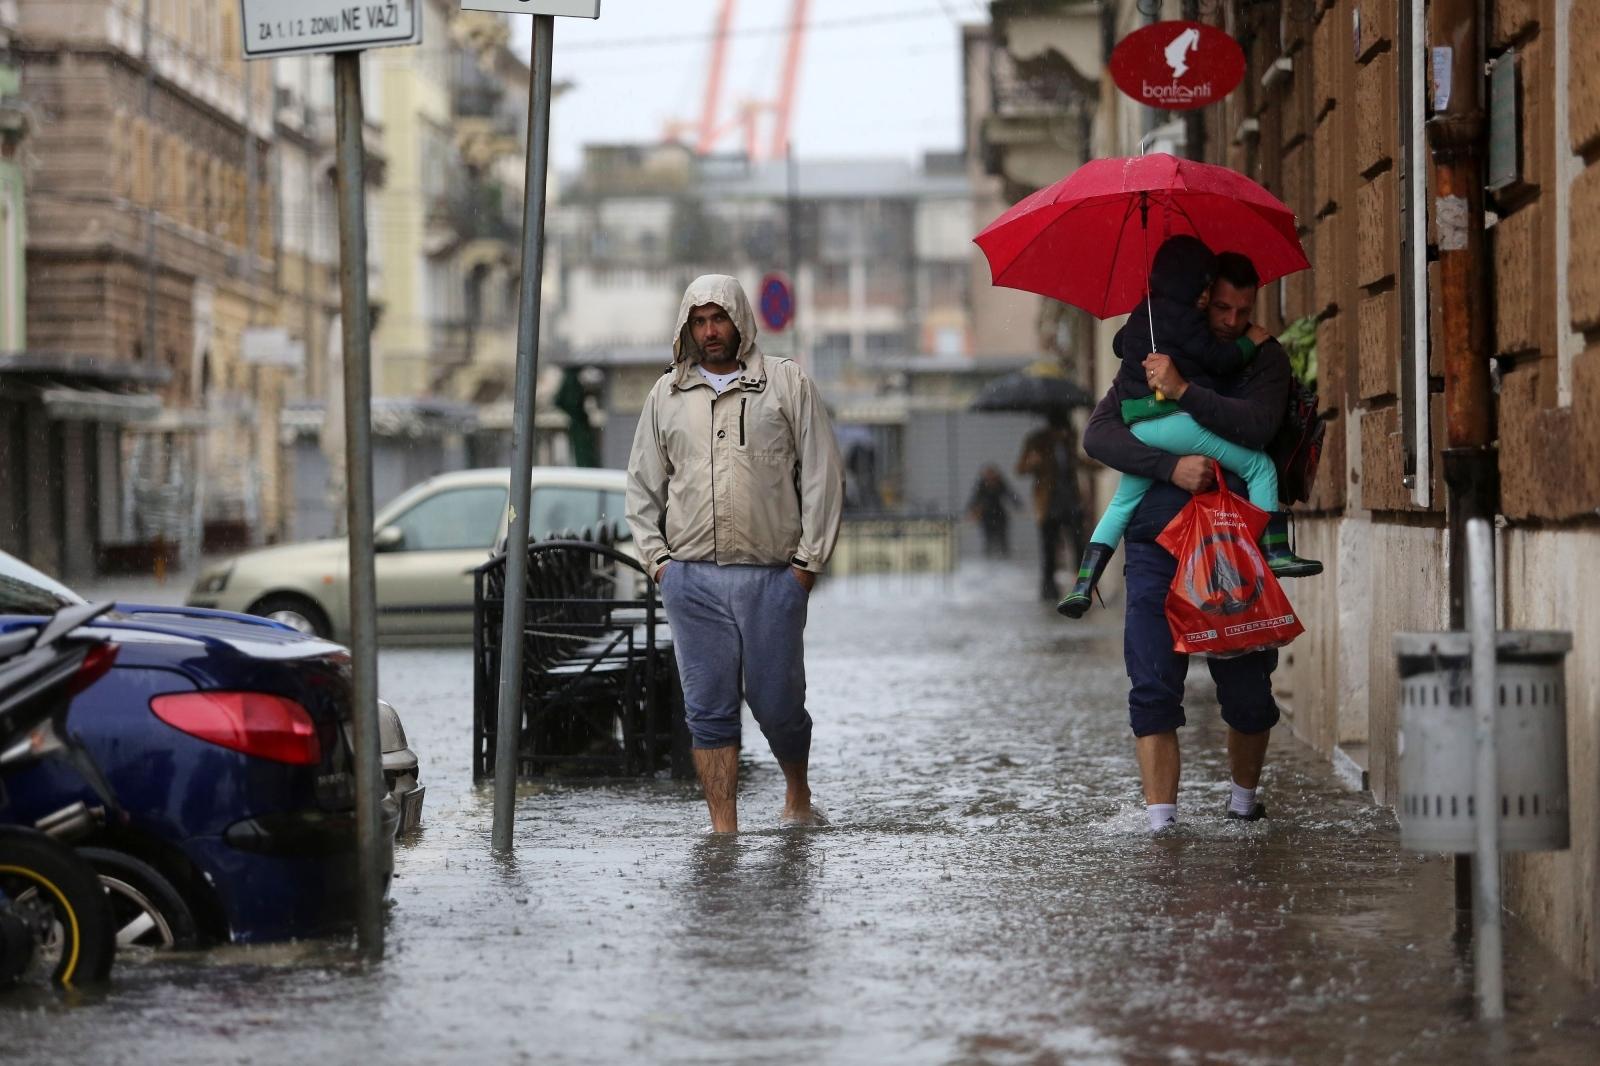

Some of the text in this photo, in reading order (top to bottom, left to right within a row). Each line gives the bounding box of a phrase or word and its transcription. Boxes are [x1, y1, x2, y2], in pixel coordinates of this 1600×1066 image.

[259, 22, 272, 40] ZA
[277, 23, 284, 38] 1.
[310, 15, 339, 36] ZONU
[341, 7, 361, 30] NE
[366, 0, 399, 29] VAŽI
[1229, 617, 1286, 634] INTERSPAR
